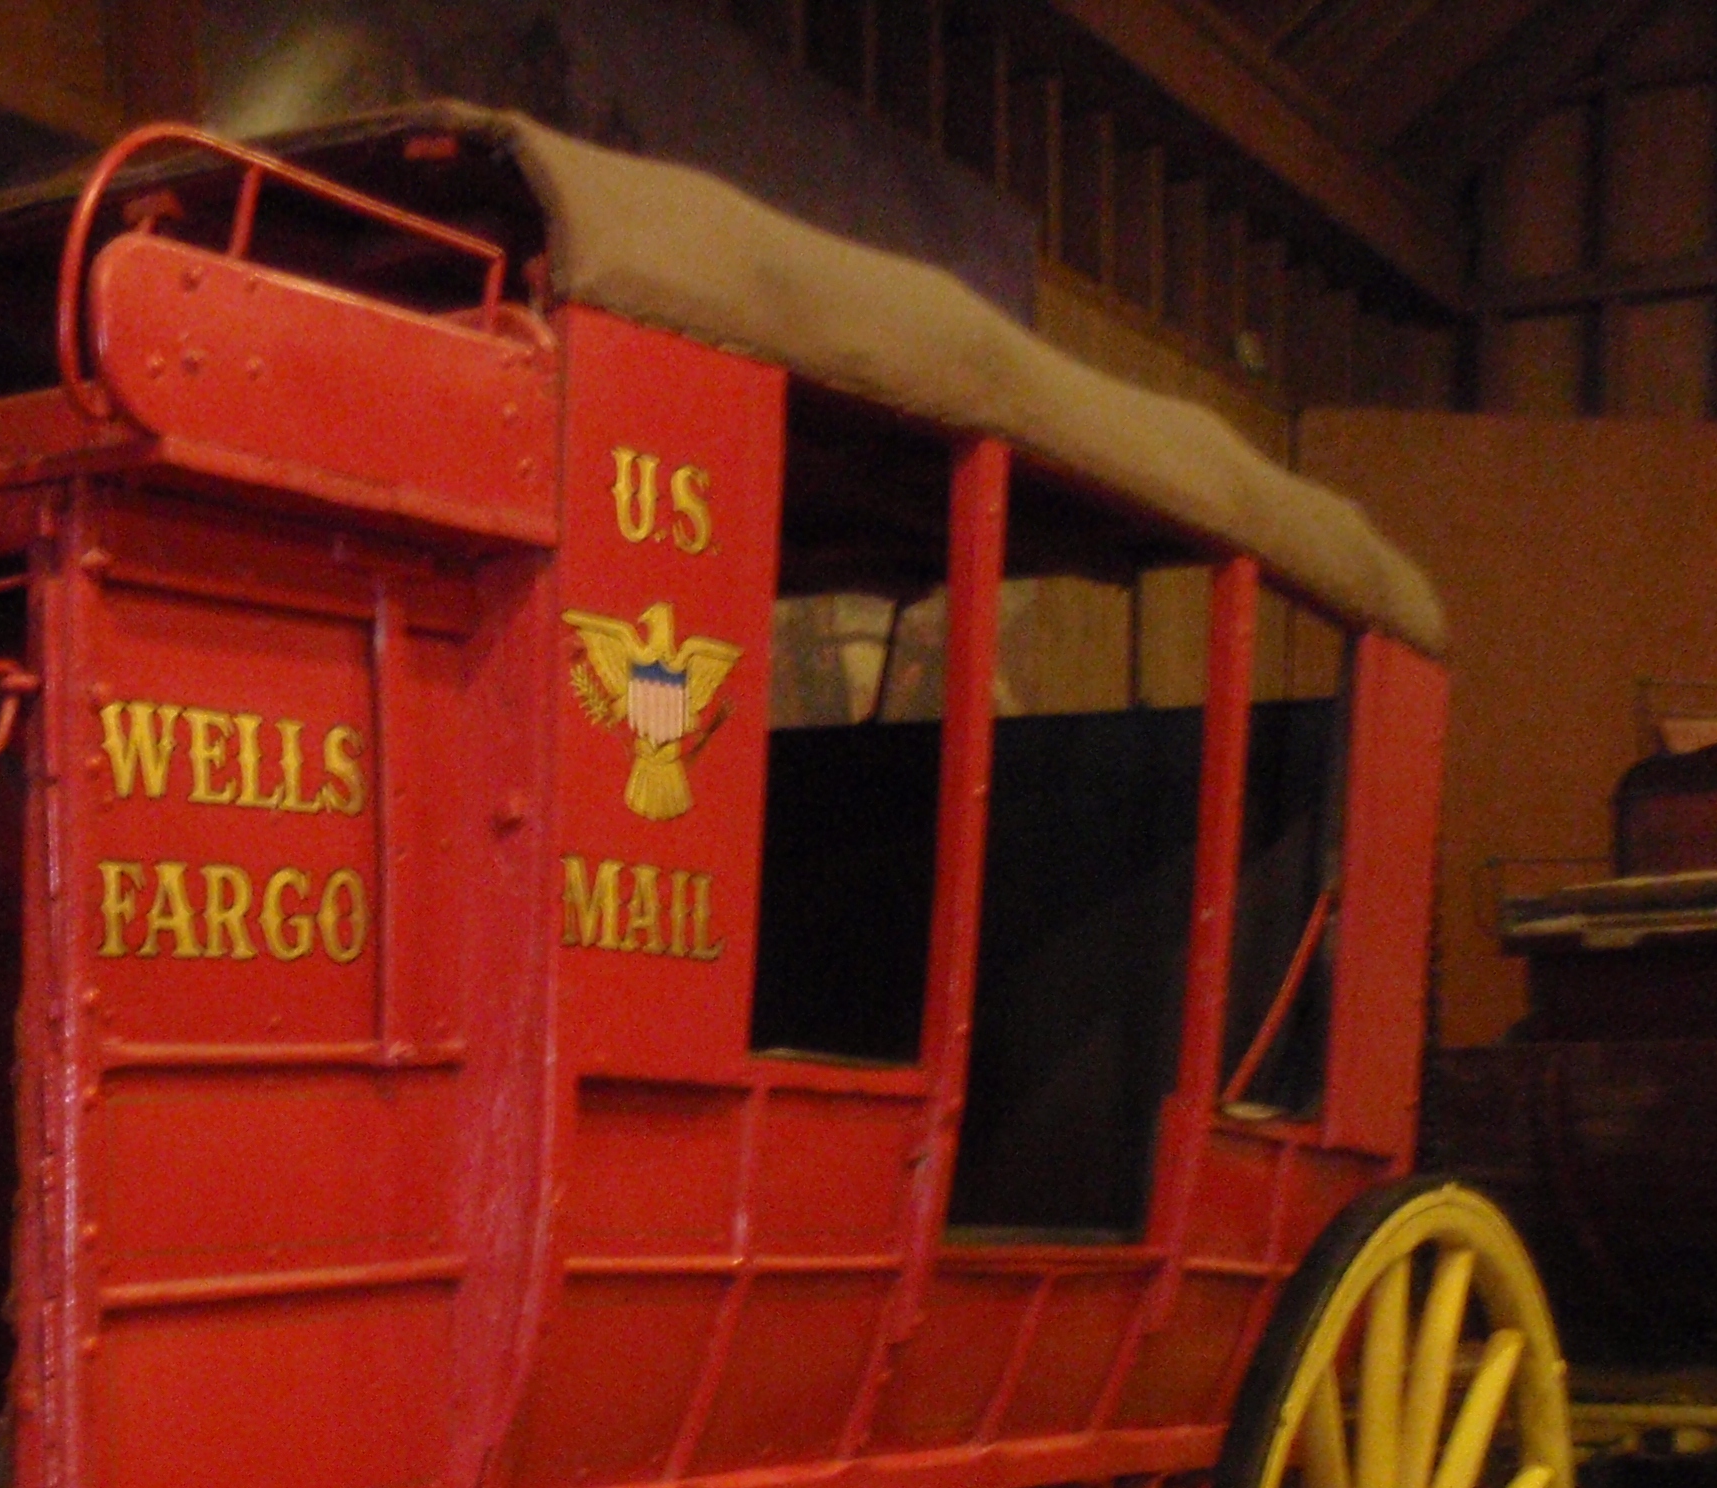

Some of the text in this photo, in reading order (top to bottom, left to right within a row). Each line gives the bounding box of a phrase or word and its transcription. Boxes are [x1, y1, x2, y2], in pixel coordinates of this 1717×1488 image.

[100, 701, 367, 817] WELLS
[98, 861, 369, 963] FARGO
[560, 855, 724, 961] MAIL
